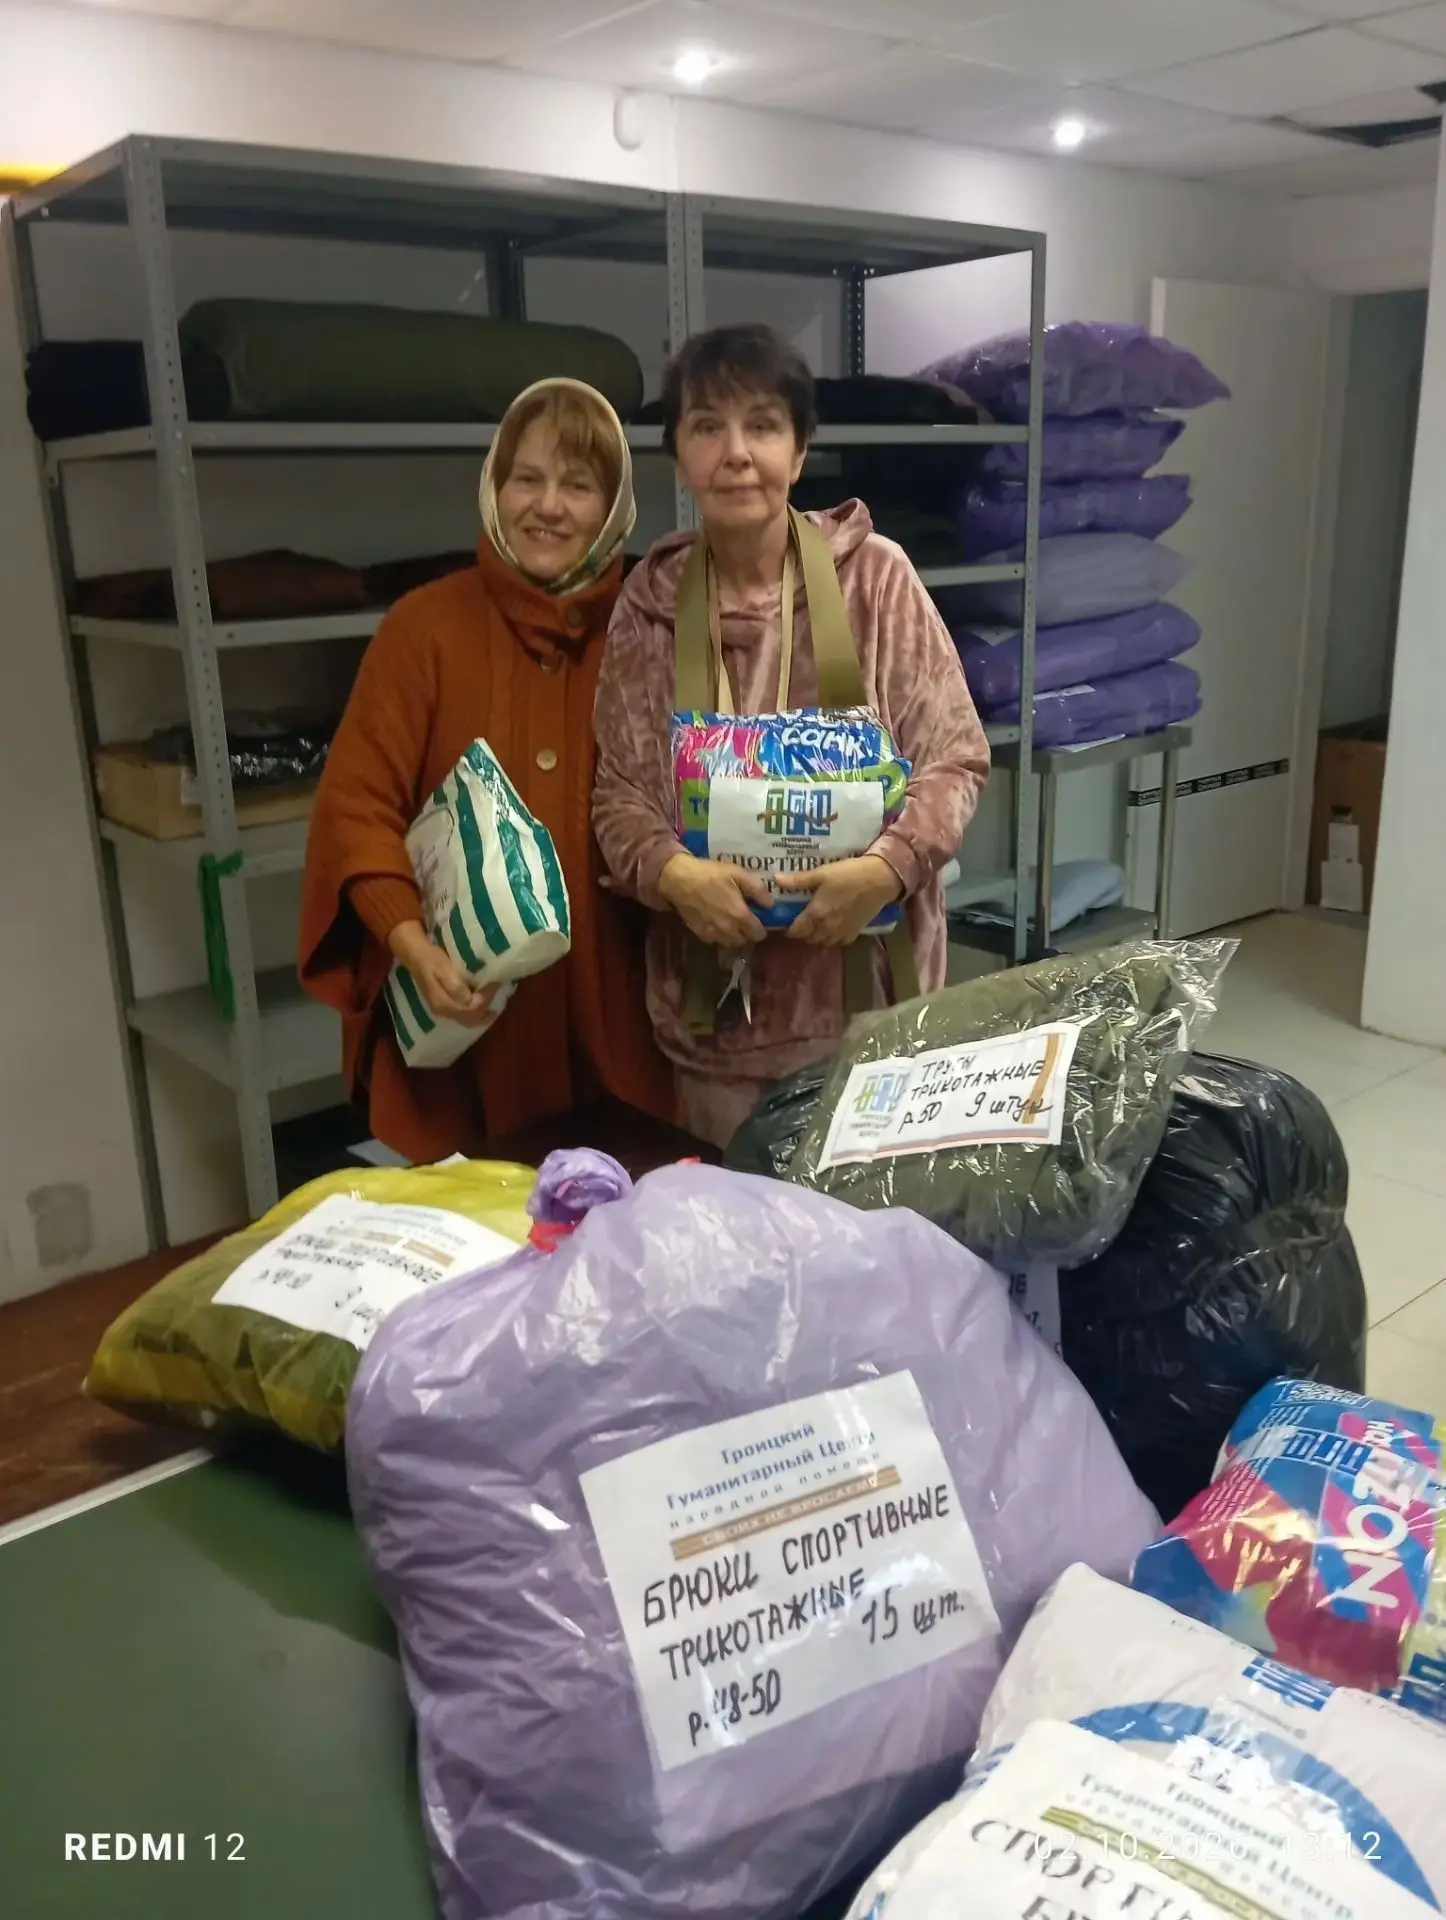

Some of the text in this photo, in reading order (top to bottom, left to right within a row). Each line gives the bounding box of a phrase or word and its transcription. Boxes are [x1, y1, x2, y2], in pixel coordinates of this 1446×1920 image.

[911, 1060, 1045, 1101] ТРИКОТАЖНЫЕ
[965, 1092, 987, 1117] 9
[721, 1424, 815, 1464] Троицкий
[666, 1450, 815, 1510] Гуманитарный
[670, 1484, 783, 1530] народной
[644, 1484, 951, 1628] БРЮКИ СПОРТИВНЫЕ
[660, 1567, 866, 1681] ТРИКОТАЖНЫЕ
[861, 1586, 901, 1645] 15
